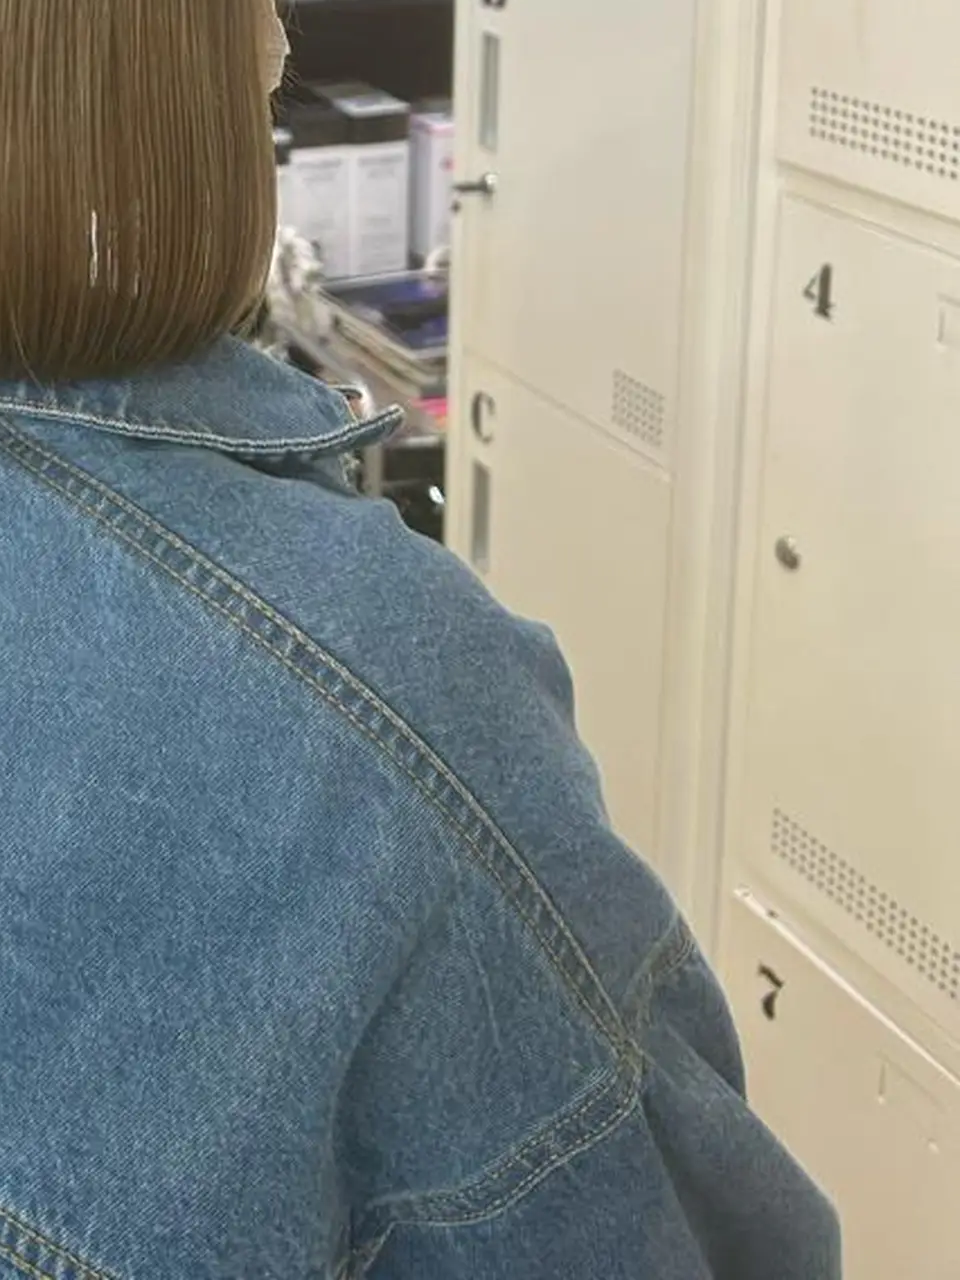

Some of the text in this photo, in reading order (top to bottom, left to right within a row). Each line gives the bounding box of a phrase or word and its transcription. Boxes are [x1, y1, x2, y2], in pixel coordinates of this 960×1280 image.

[802, 262, 836, 322] 4
[470, 390, 496, 446] C
[757, 962, 785, 1021] 7
